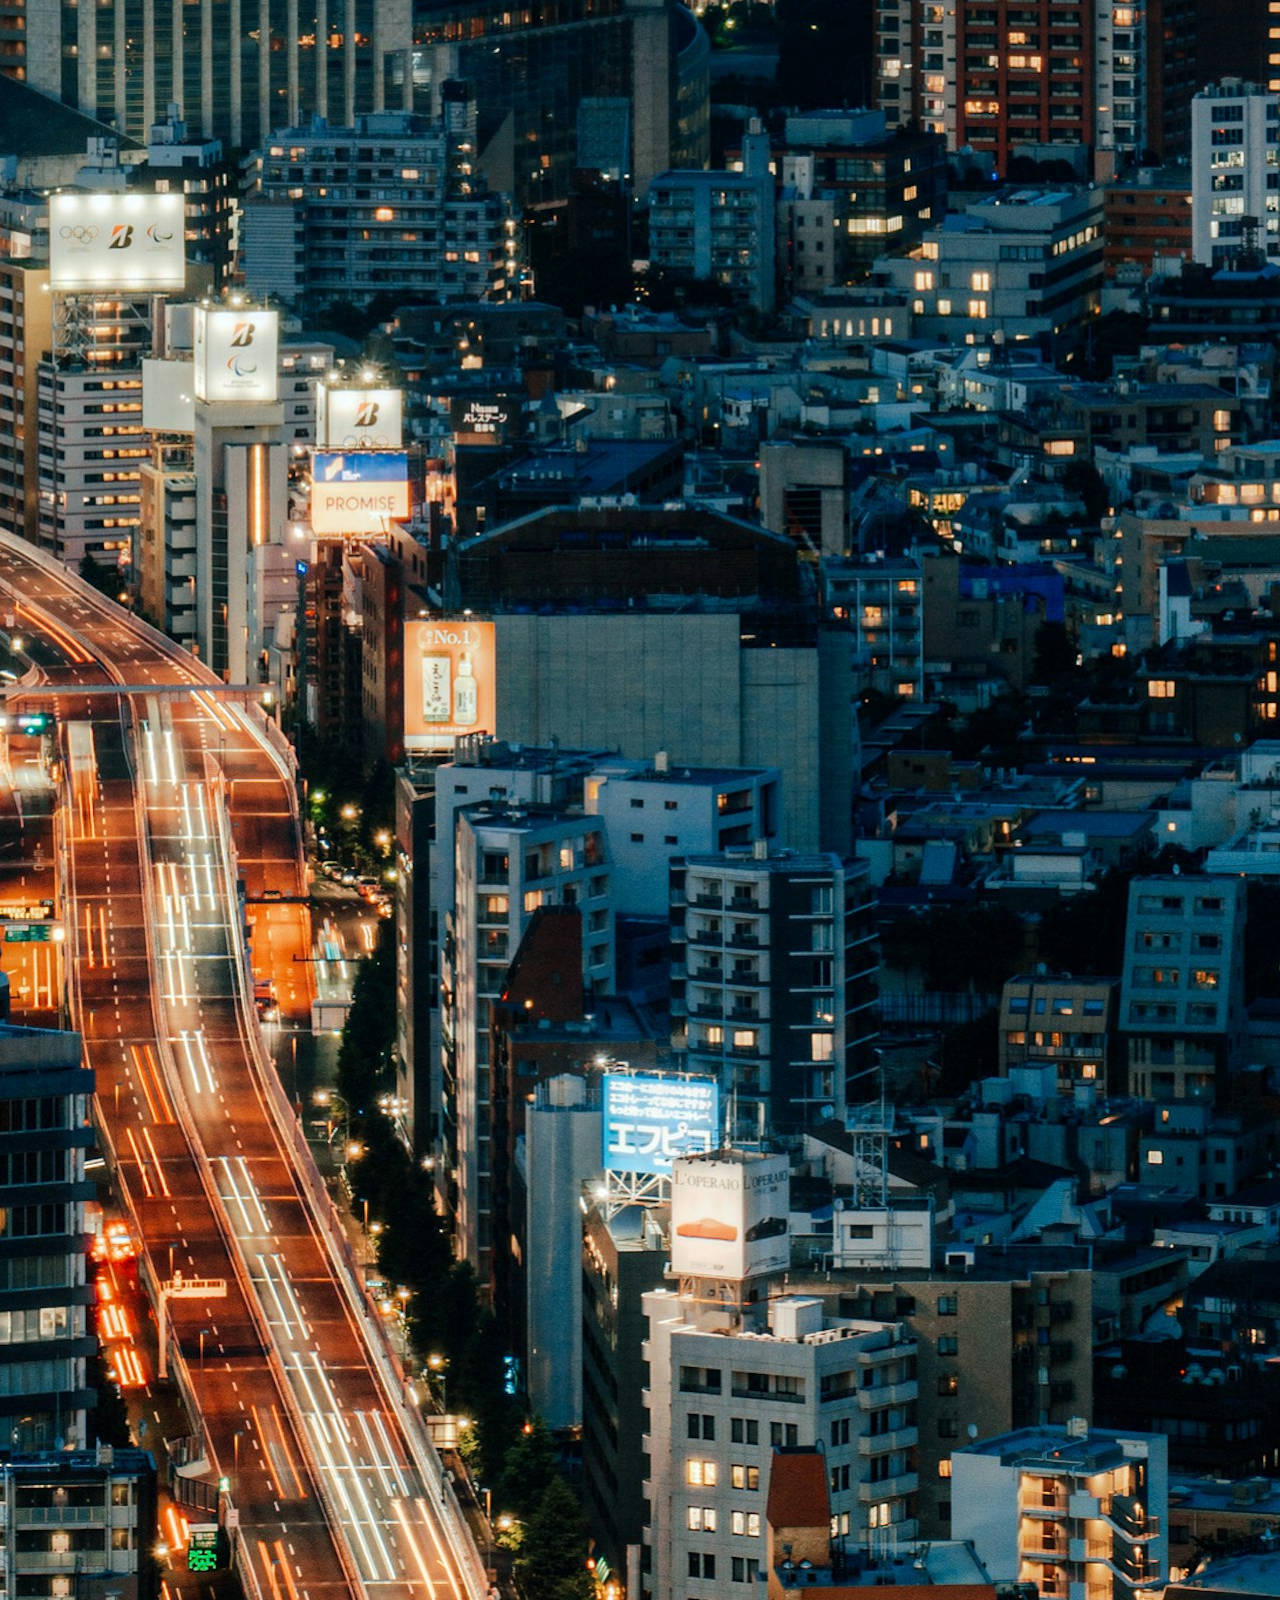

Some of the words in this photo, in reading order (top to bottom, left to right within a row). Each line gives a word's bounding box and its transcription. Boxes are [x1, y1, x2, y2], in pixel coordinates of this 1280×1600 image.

[326, 496, 395, 511] PROMISE
[434, 629, 471, 645] No.1
[608, 1122, 712, 1156] エフピコ
[673, 1170, 739, 1191] L'OPERAIO
[743, 1169, 789, 1190] L'OPERAIO
